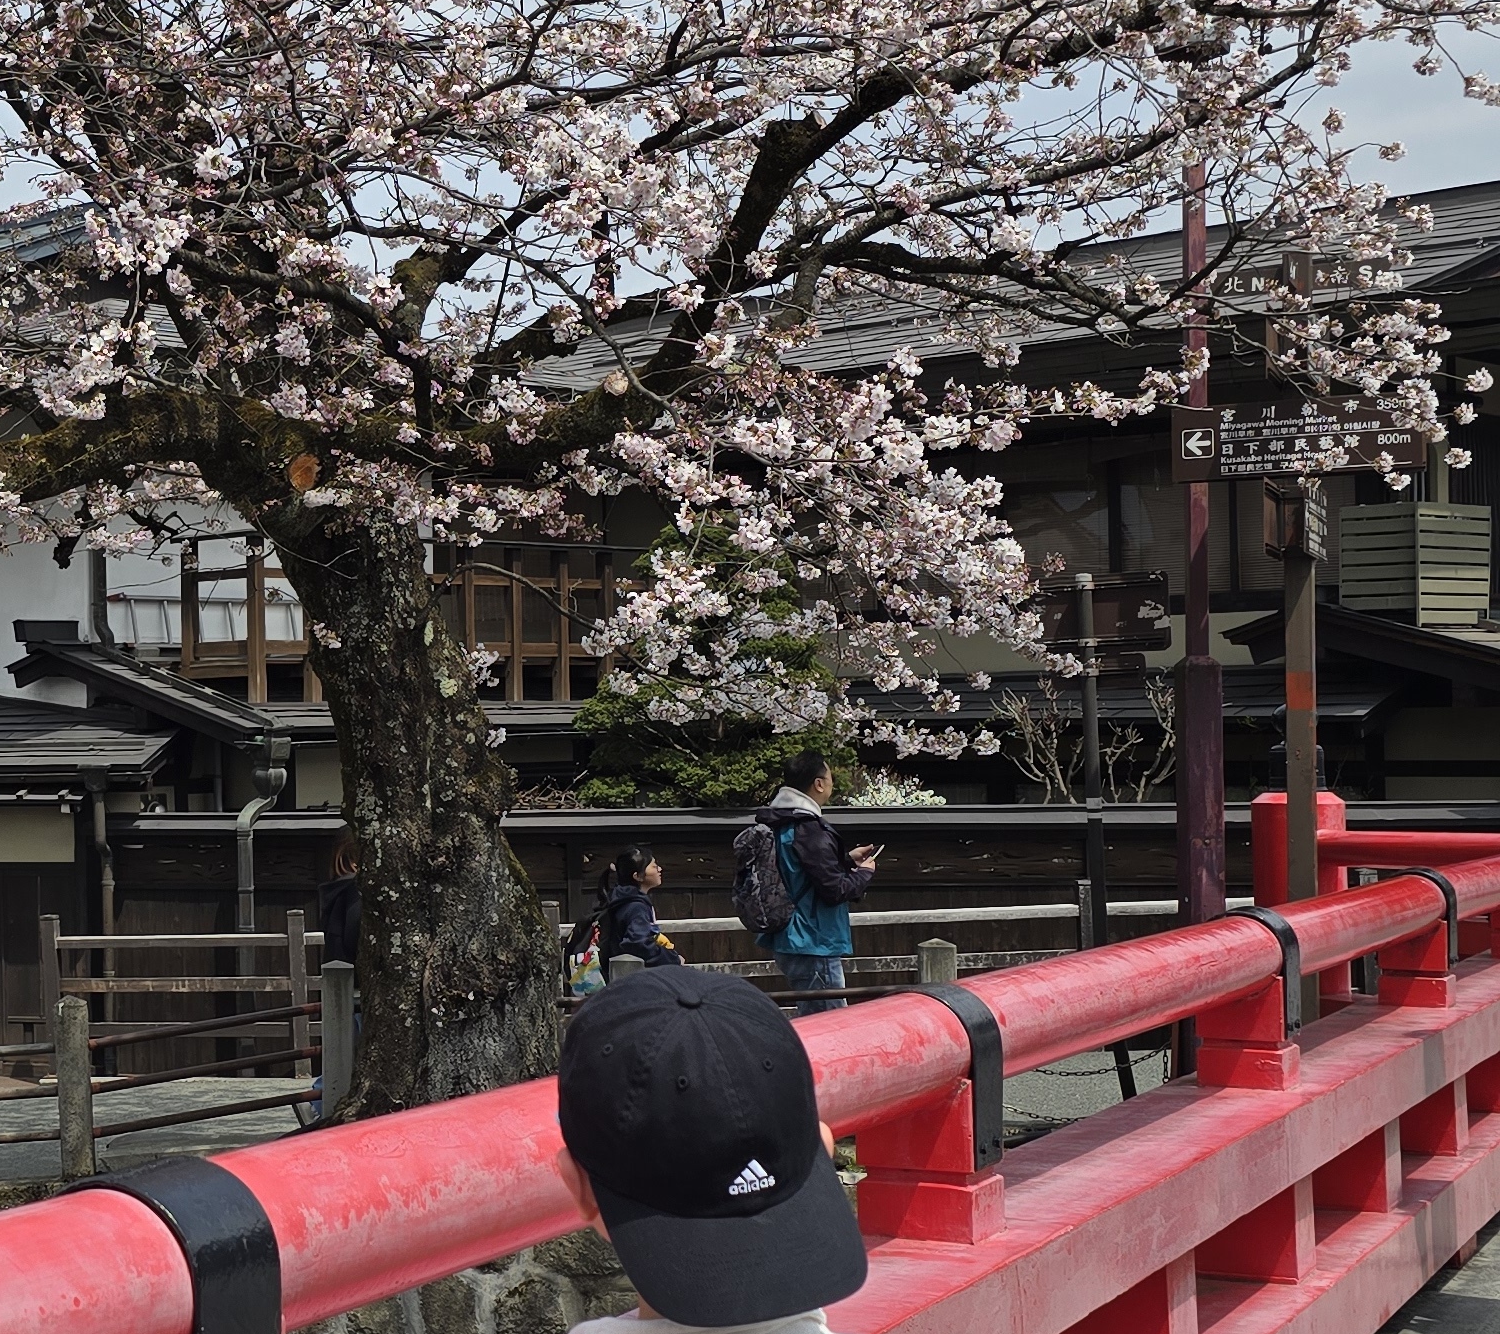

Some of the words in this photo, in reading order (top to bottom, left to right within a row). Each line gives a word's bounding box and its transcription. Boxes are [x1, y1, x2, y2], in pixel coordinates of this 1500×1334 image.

[1223, 276, 1245, 294] 北
[1251, 277, 1265, 292] N
[1220, 421, 1265, 431] Miyagawa
[1265, 417, 1304, 427] Morning
[1377, 432, 1411, 445] 800m
[1220, 454, 1263, 464] Kusakabe
[1263, 451, 1303, 462] Heritage
[728, 1175, 776, 1196] adidas
